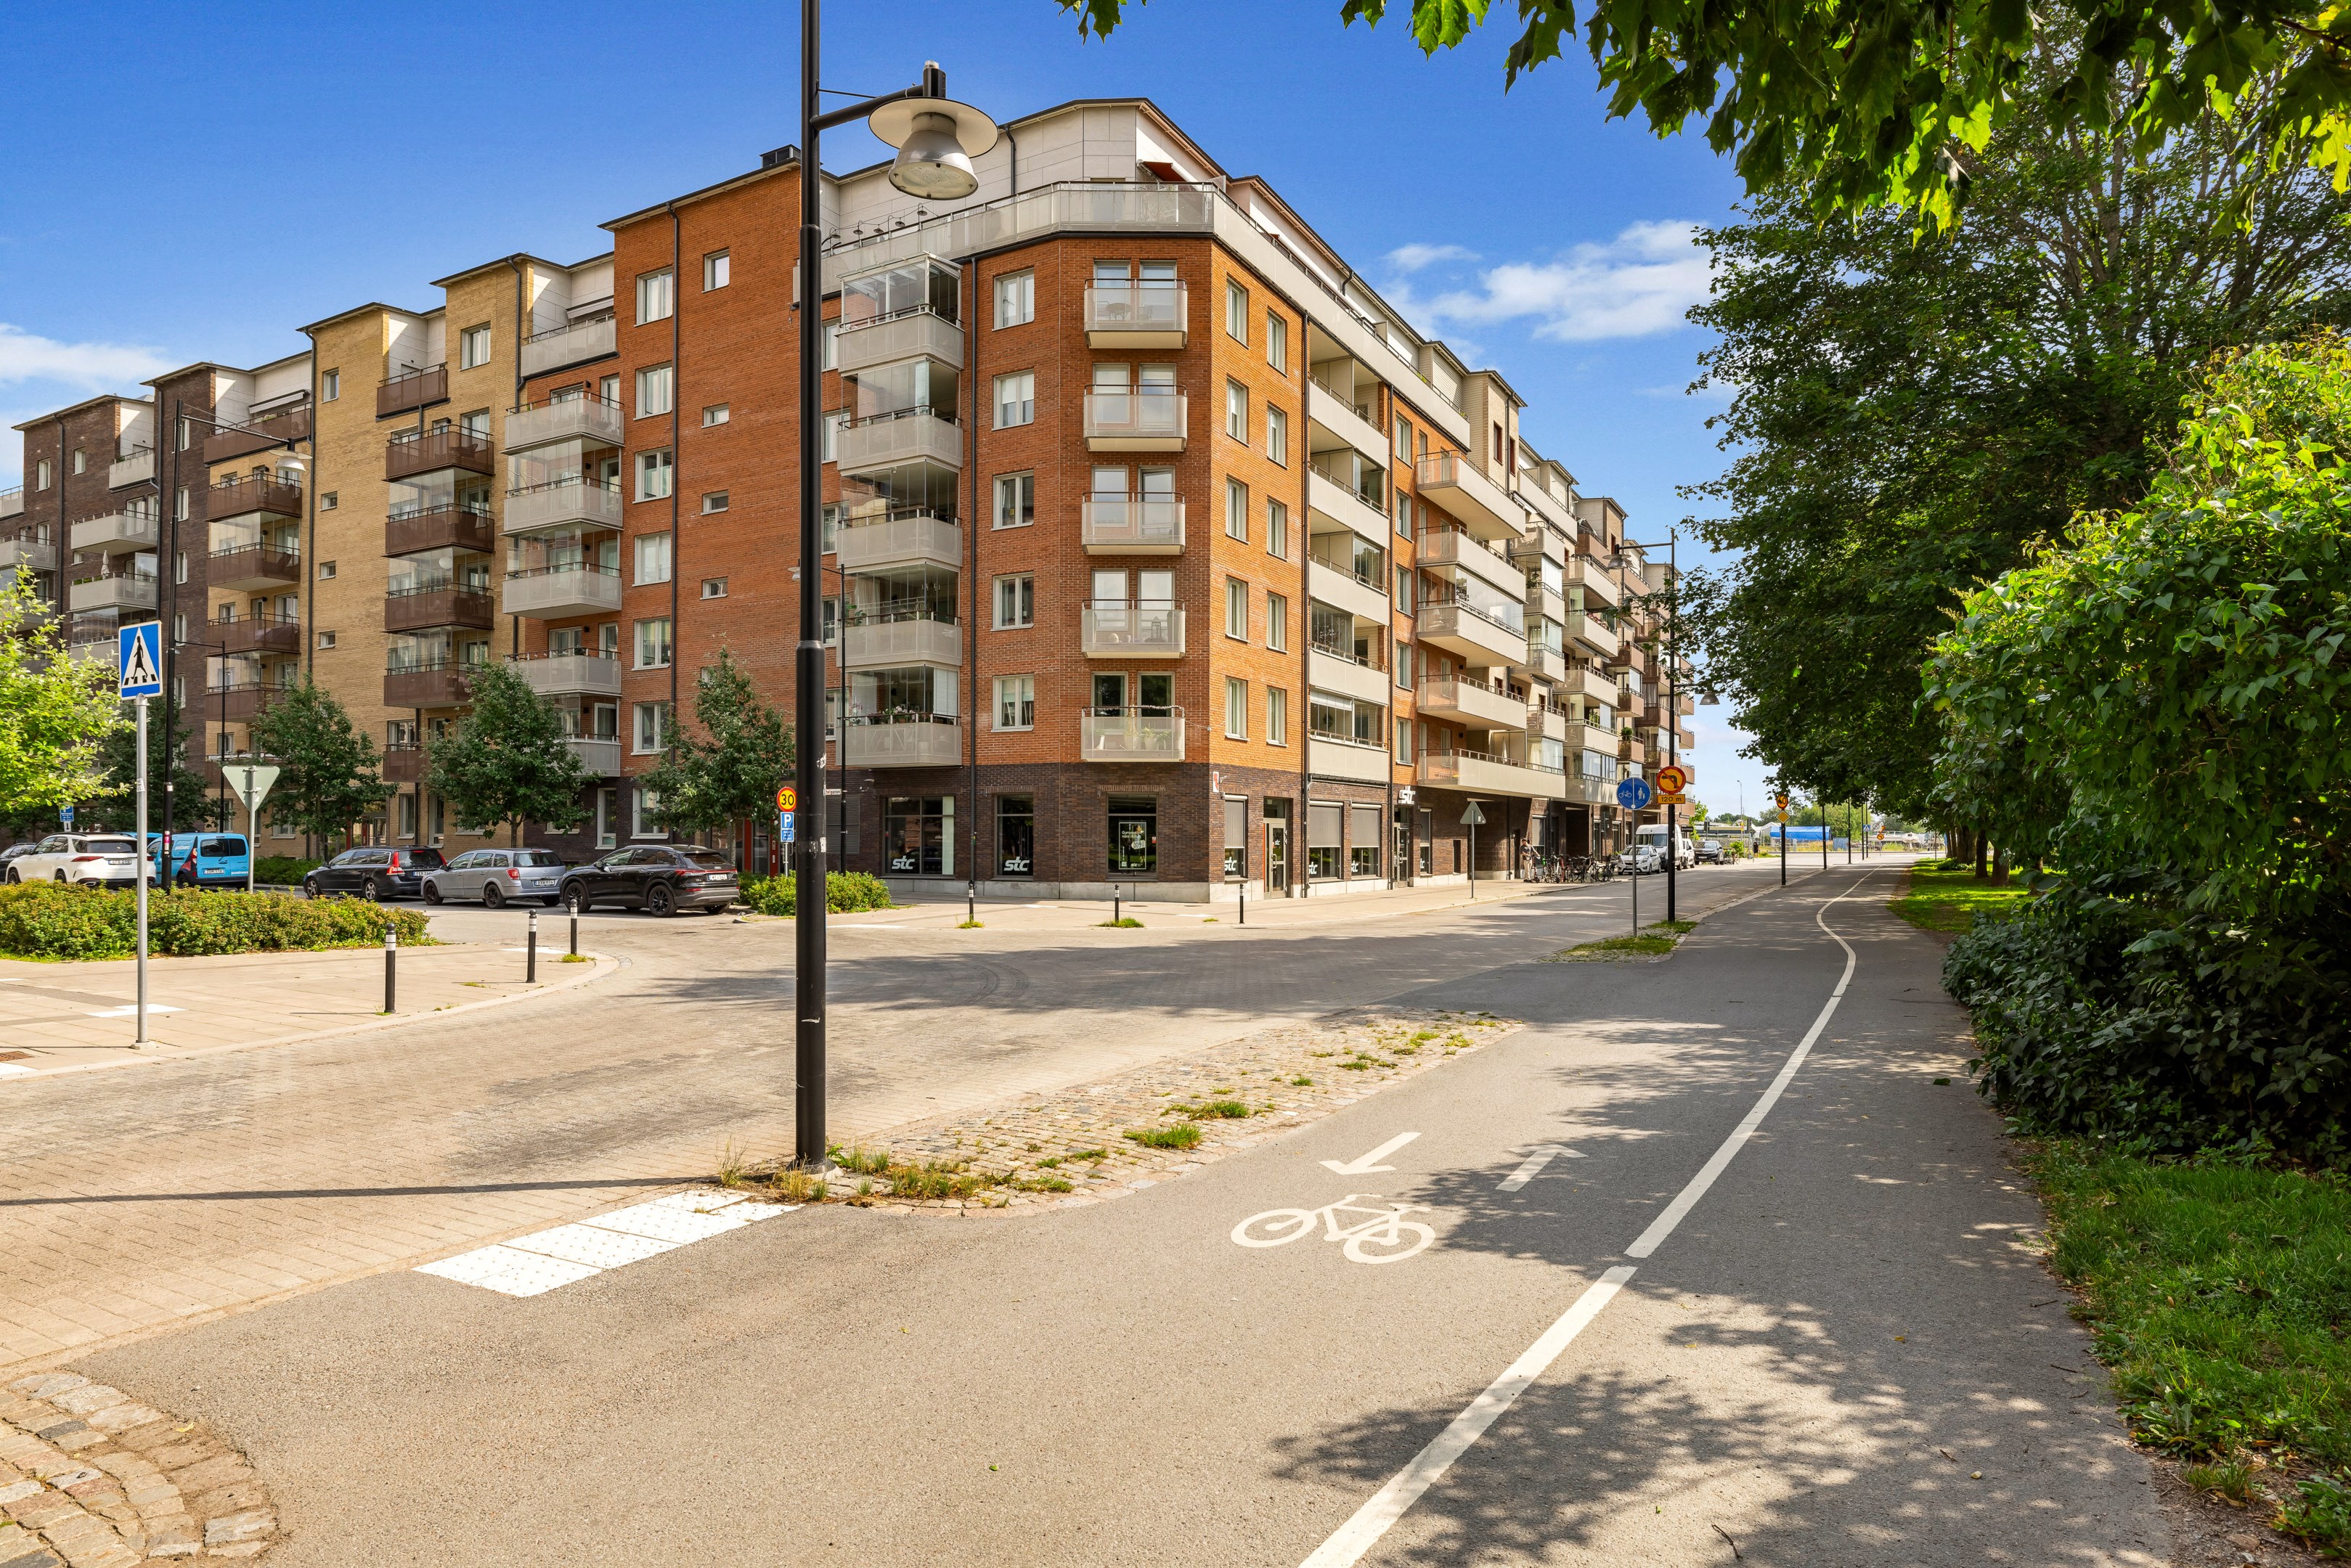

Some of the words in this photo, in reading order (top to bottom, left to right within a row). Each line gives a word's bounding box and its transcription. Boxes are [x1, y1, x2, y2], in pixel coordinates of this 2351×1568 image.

[781, 794, 794, 806] 30
[1398, 785, 1416, 805] stc
[784, 814, 791, 827] P
[892, 856, 915, 870] stc
[1003, 857, 1030, 871] stc
